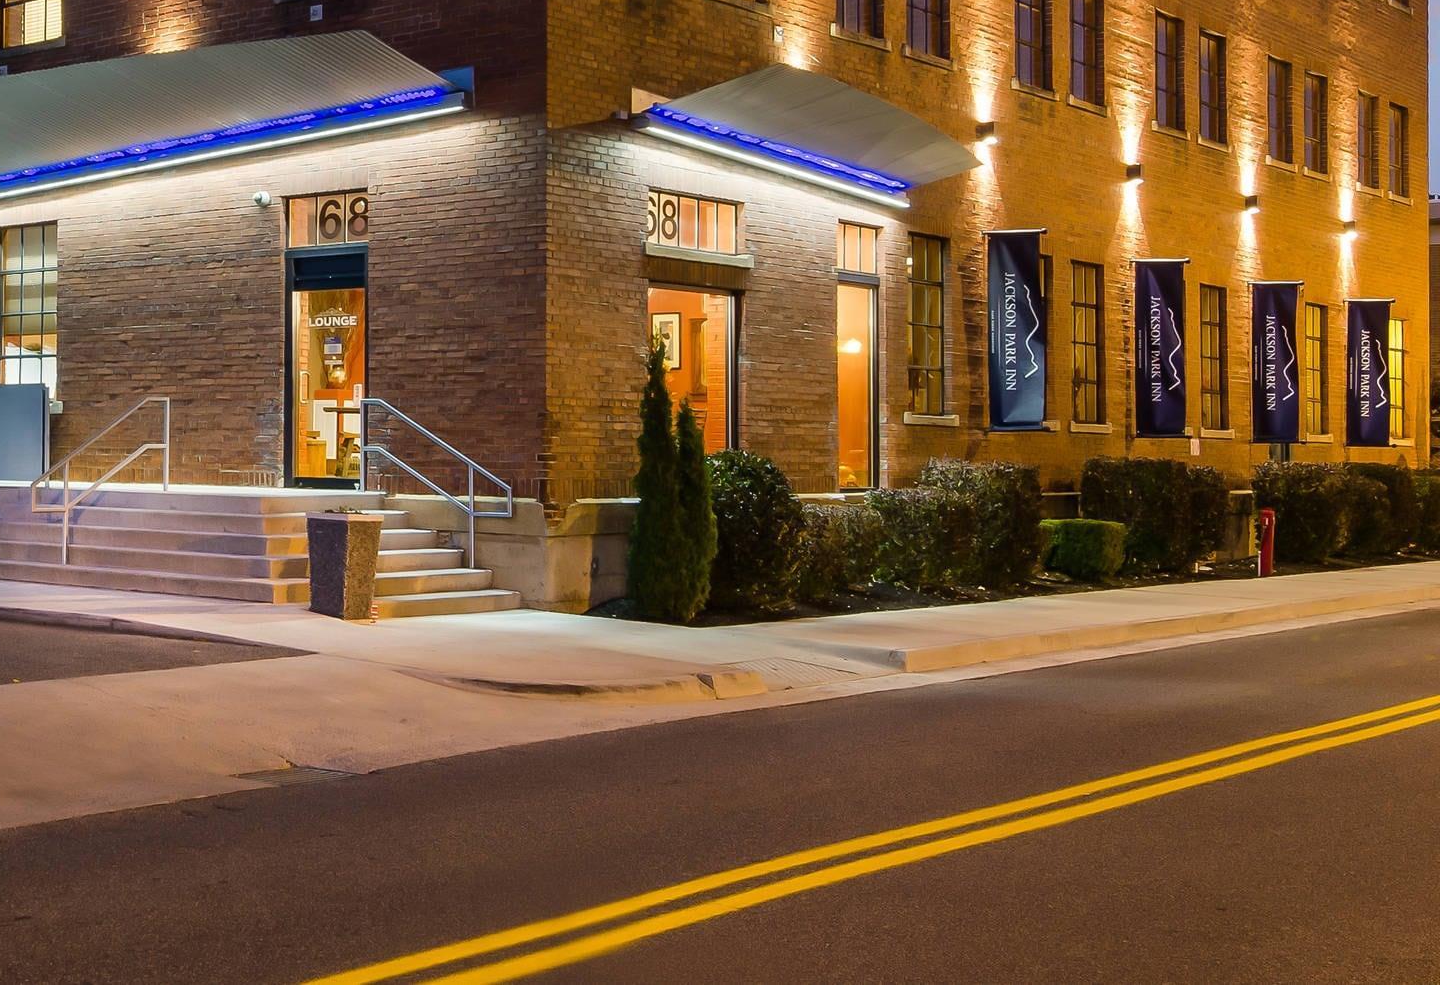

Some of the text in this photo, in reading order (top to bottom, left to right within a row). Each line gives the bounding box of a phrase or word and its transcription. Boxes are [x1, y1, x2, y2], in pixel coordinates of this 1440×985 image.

[319, 197, 369, 239] 68
[646, 196, 677, 240] 68
[308, 315, 358, 327] LOUNGE
[1004, 272, 1017, 391] JACKSON PARK INN
[1150, 296, 1162, 402] JACKSON PARK INN
[1265, 315, 1277, 411] JACKSON PARK INN
[1360, 329, 1371, 417] JACKSON PARK INN
